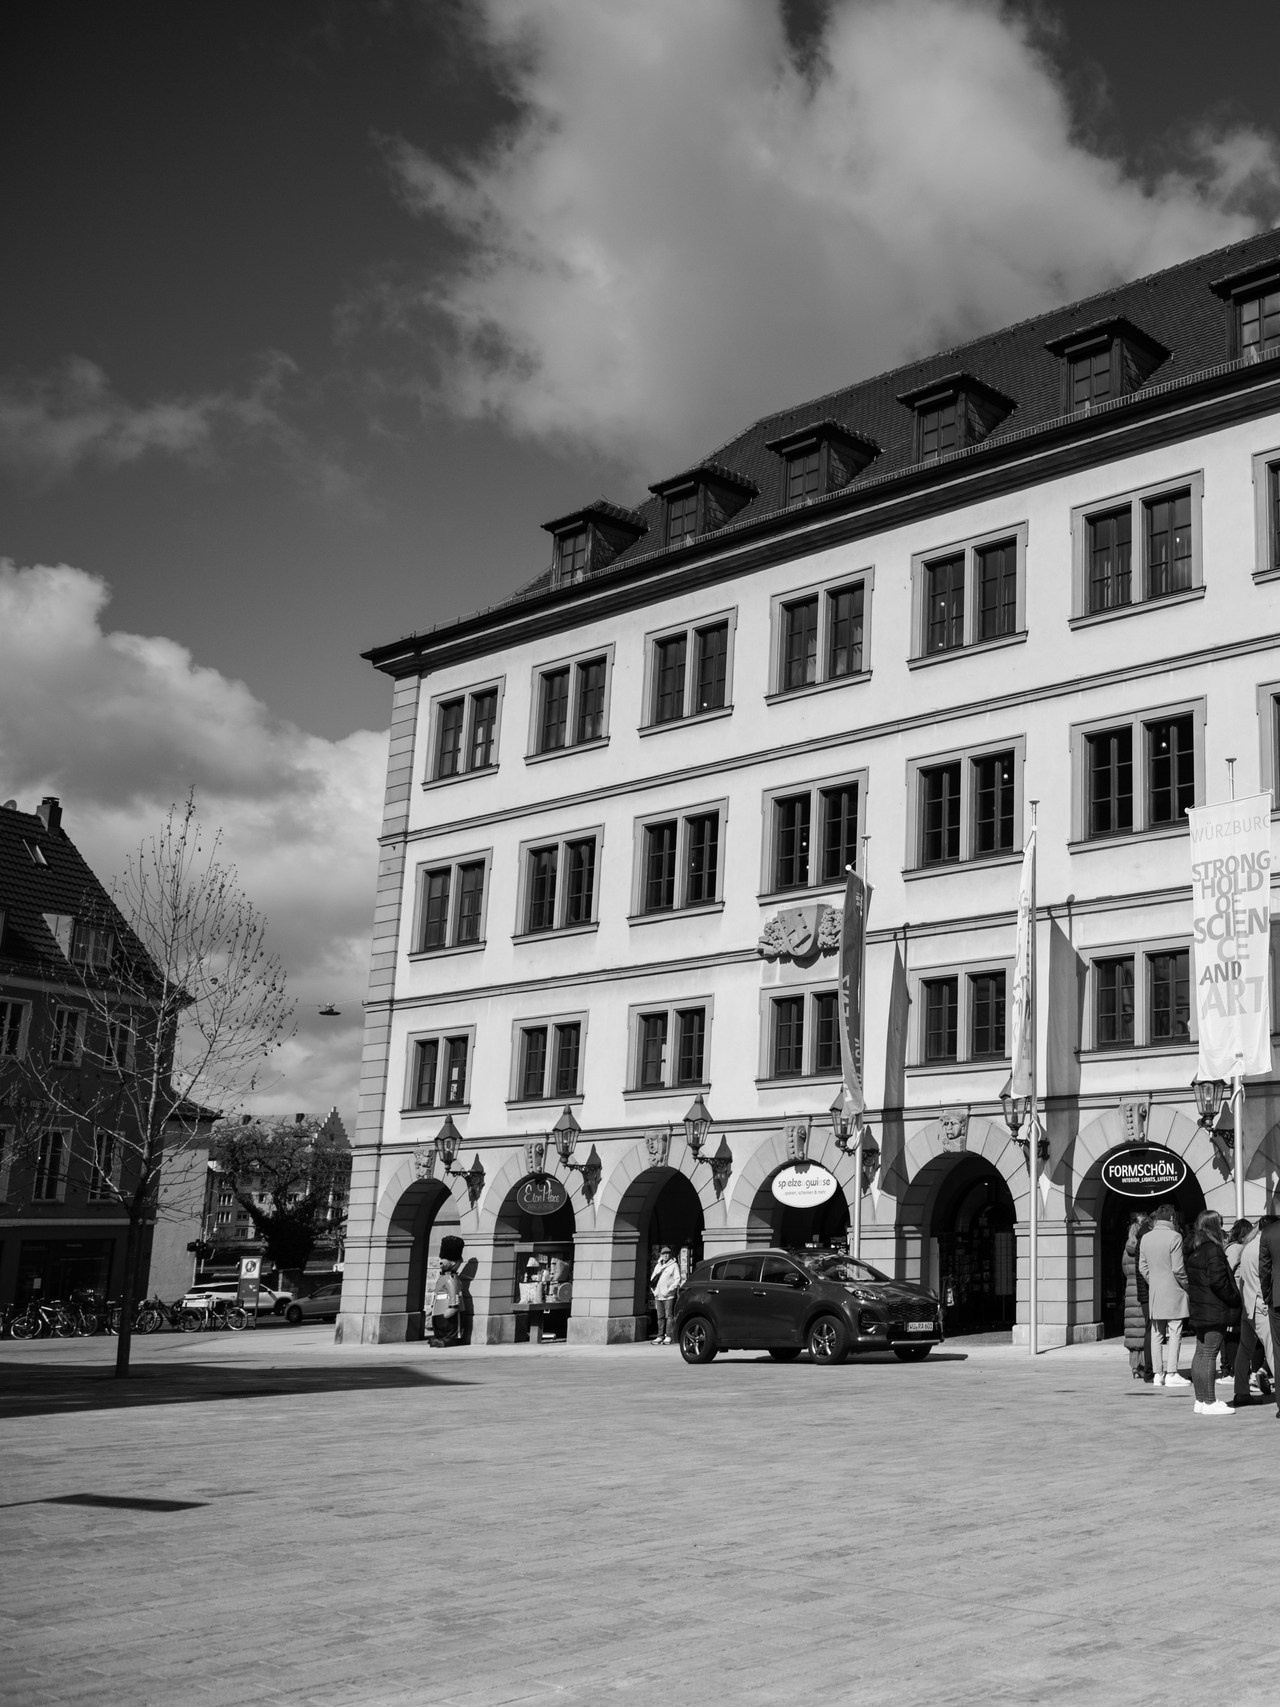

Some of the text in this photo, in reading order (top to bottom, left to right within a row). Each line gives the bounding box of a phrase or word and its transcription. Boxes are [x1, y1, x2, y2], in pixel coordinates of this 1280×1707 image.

[1191, 850, 1271, 883] STRONG
[1201, 868, 1264, 900] HOLD
[1193, 906, 1269, 944] SCIEN
[1216, 934, 1250, 963] CE
[1199, 960, 1242, 986] AND
[1201, 976, 1265, 1020] ART
